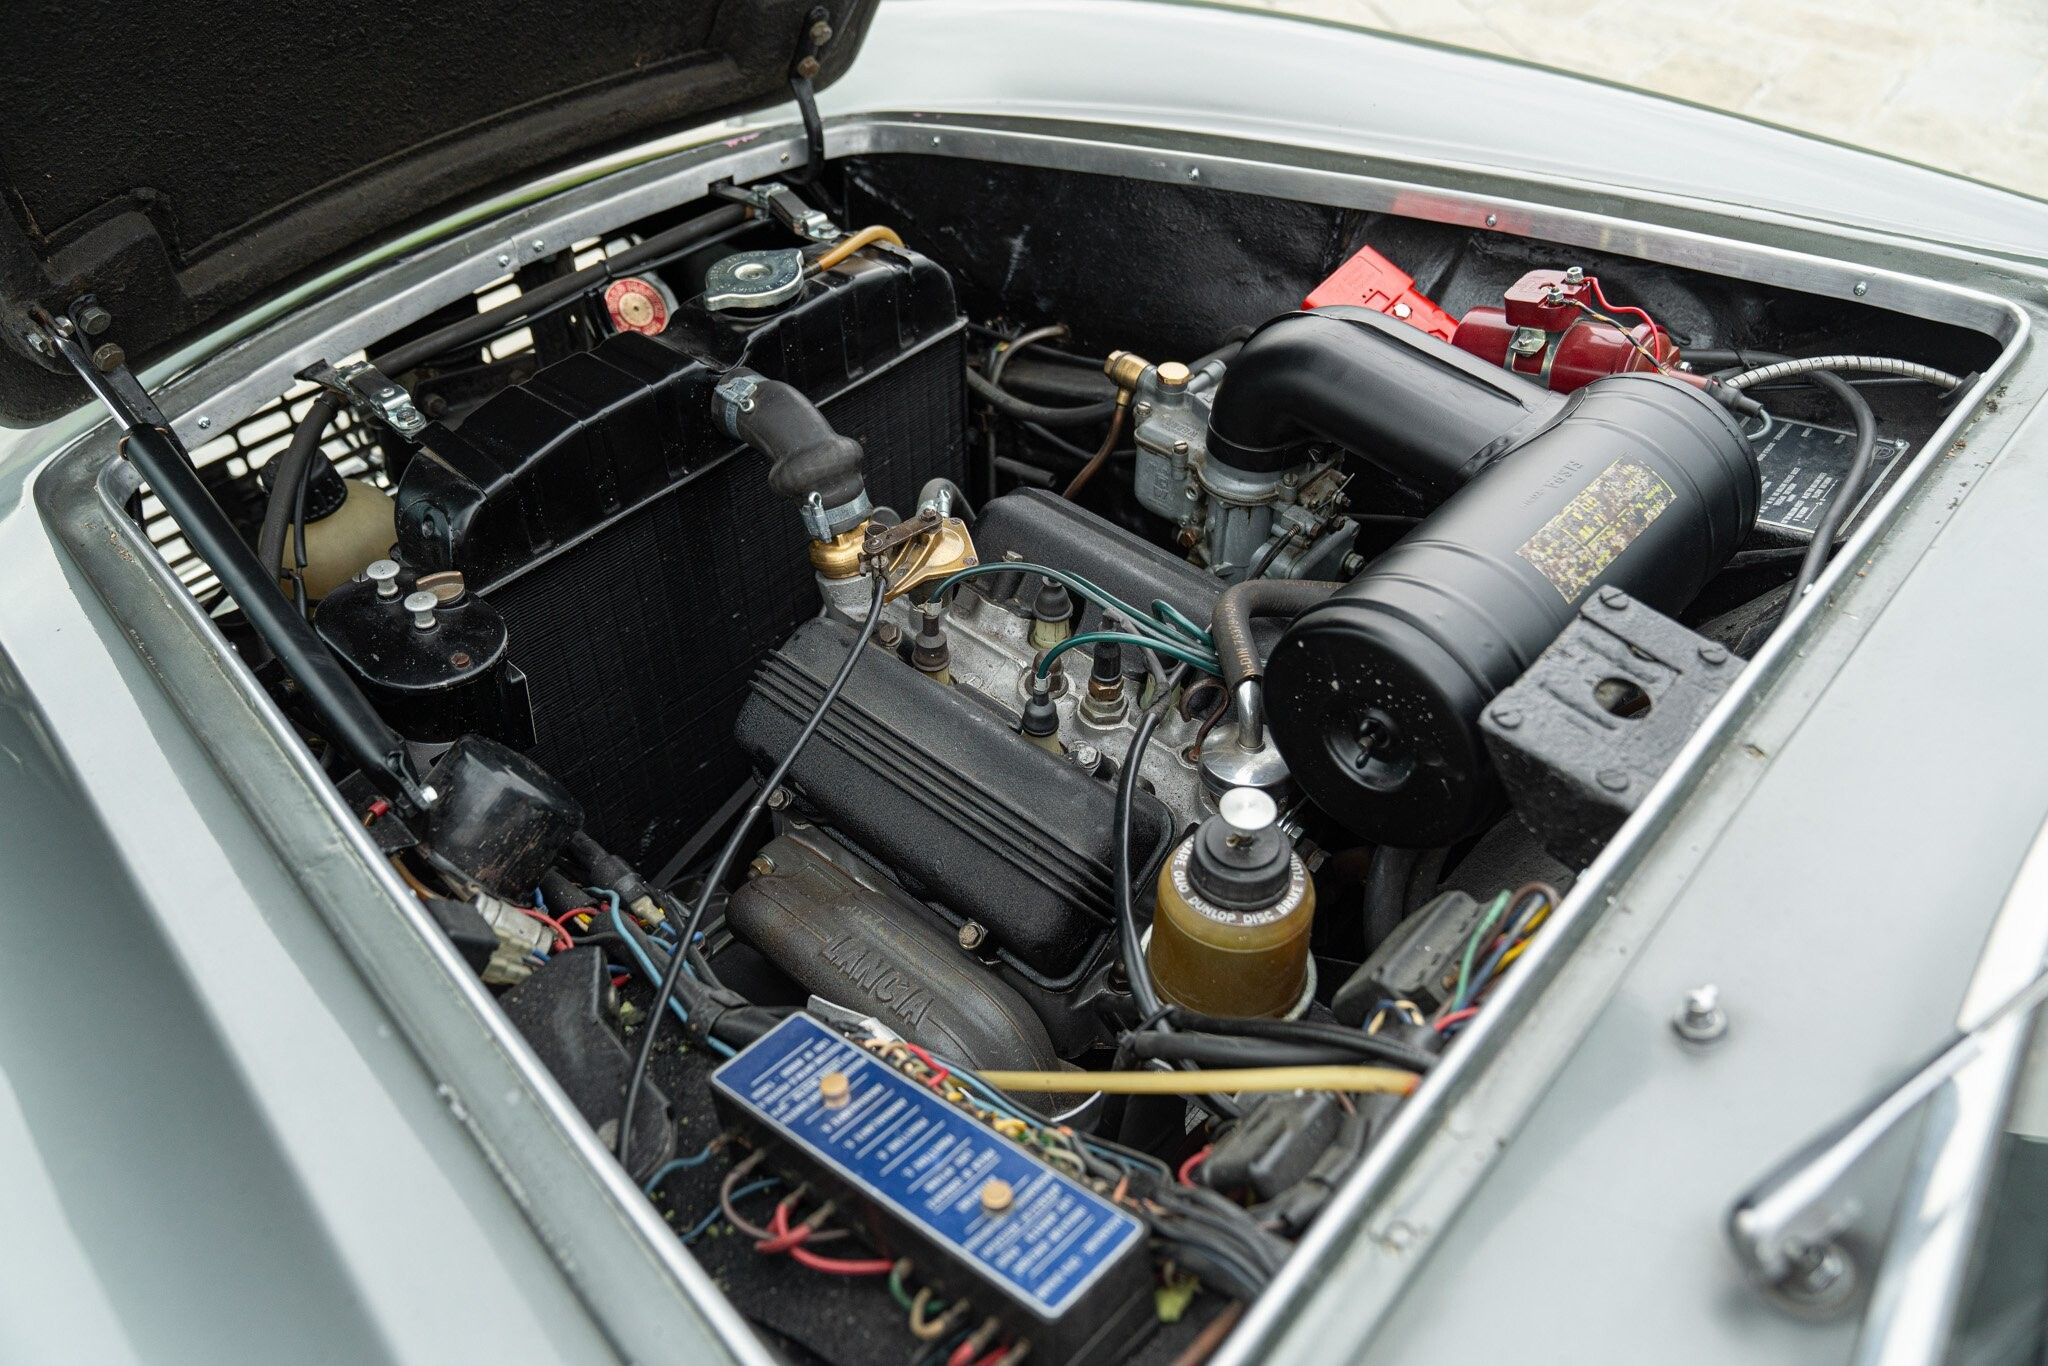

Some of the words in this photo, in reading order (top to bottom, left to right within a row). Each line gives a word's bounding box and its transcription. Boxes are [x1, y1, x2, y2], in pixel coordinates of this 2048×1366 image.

[1173, 870, 1190, 893] OLIO
[1188, 896, 1238, 924] DUNLOP
[1242, 910, 1274, 926] DISC
[1275, 884, 1304, 915] BRAKE
[822, 935, 935, 1026] LANCIA
